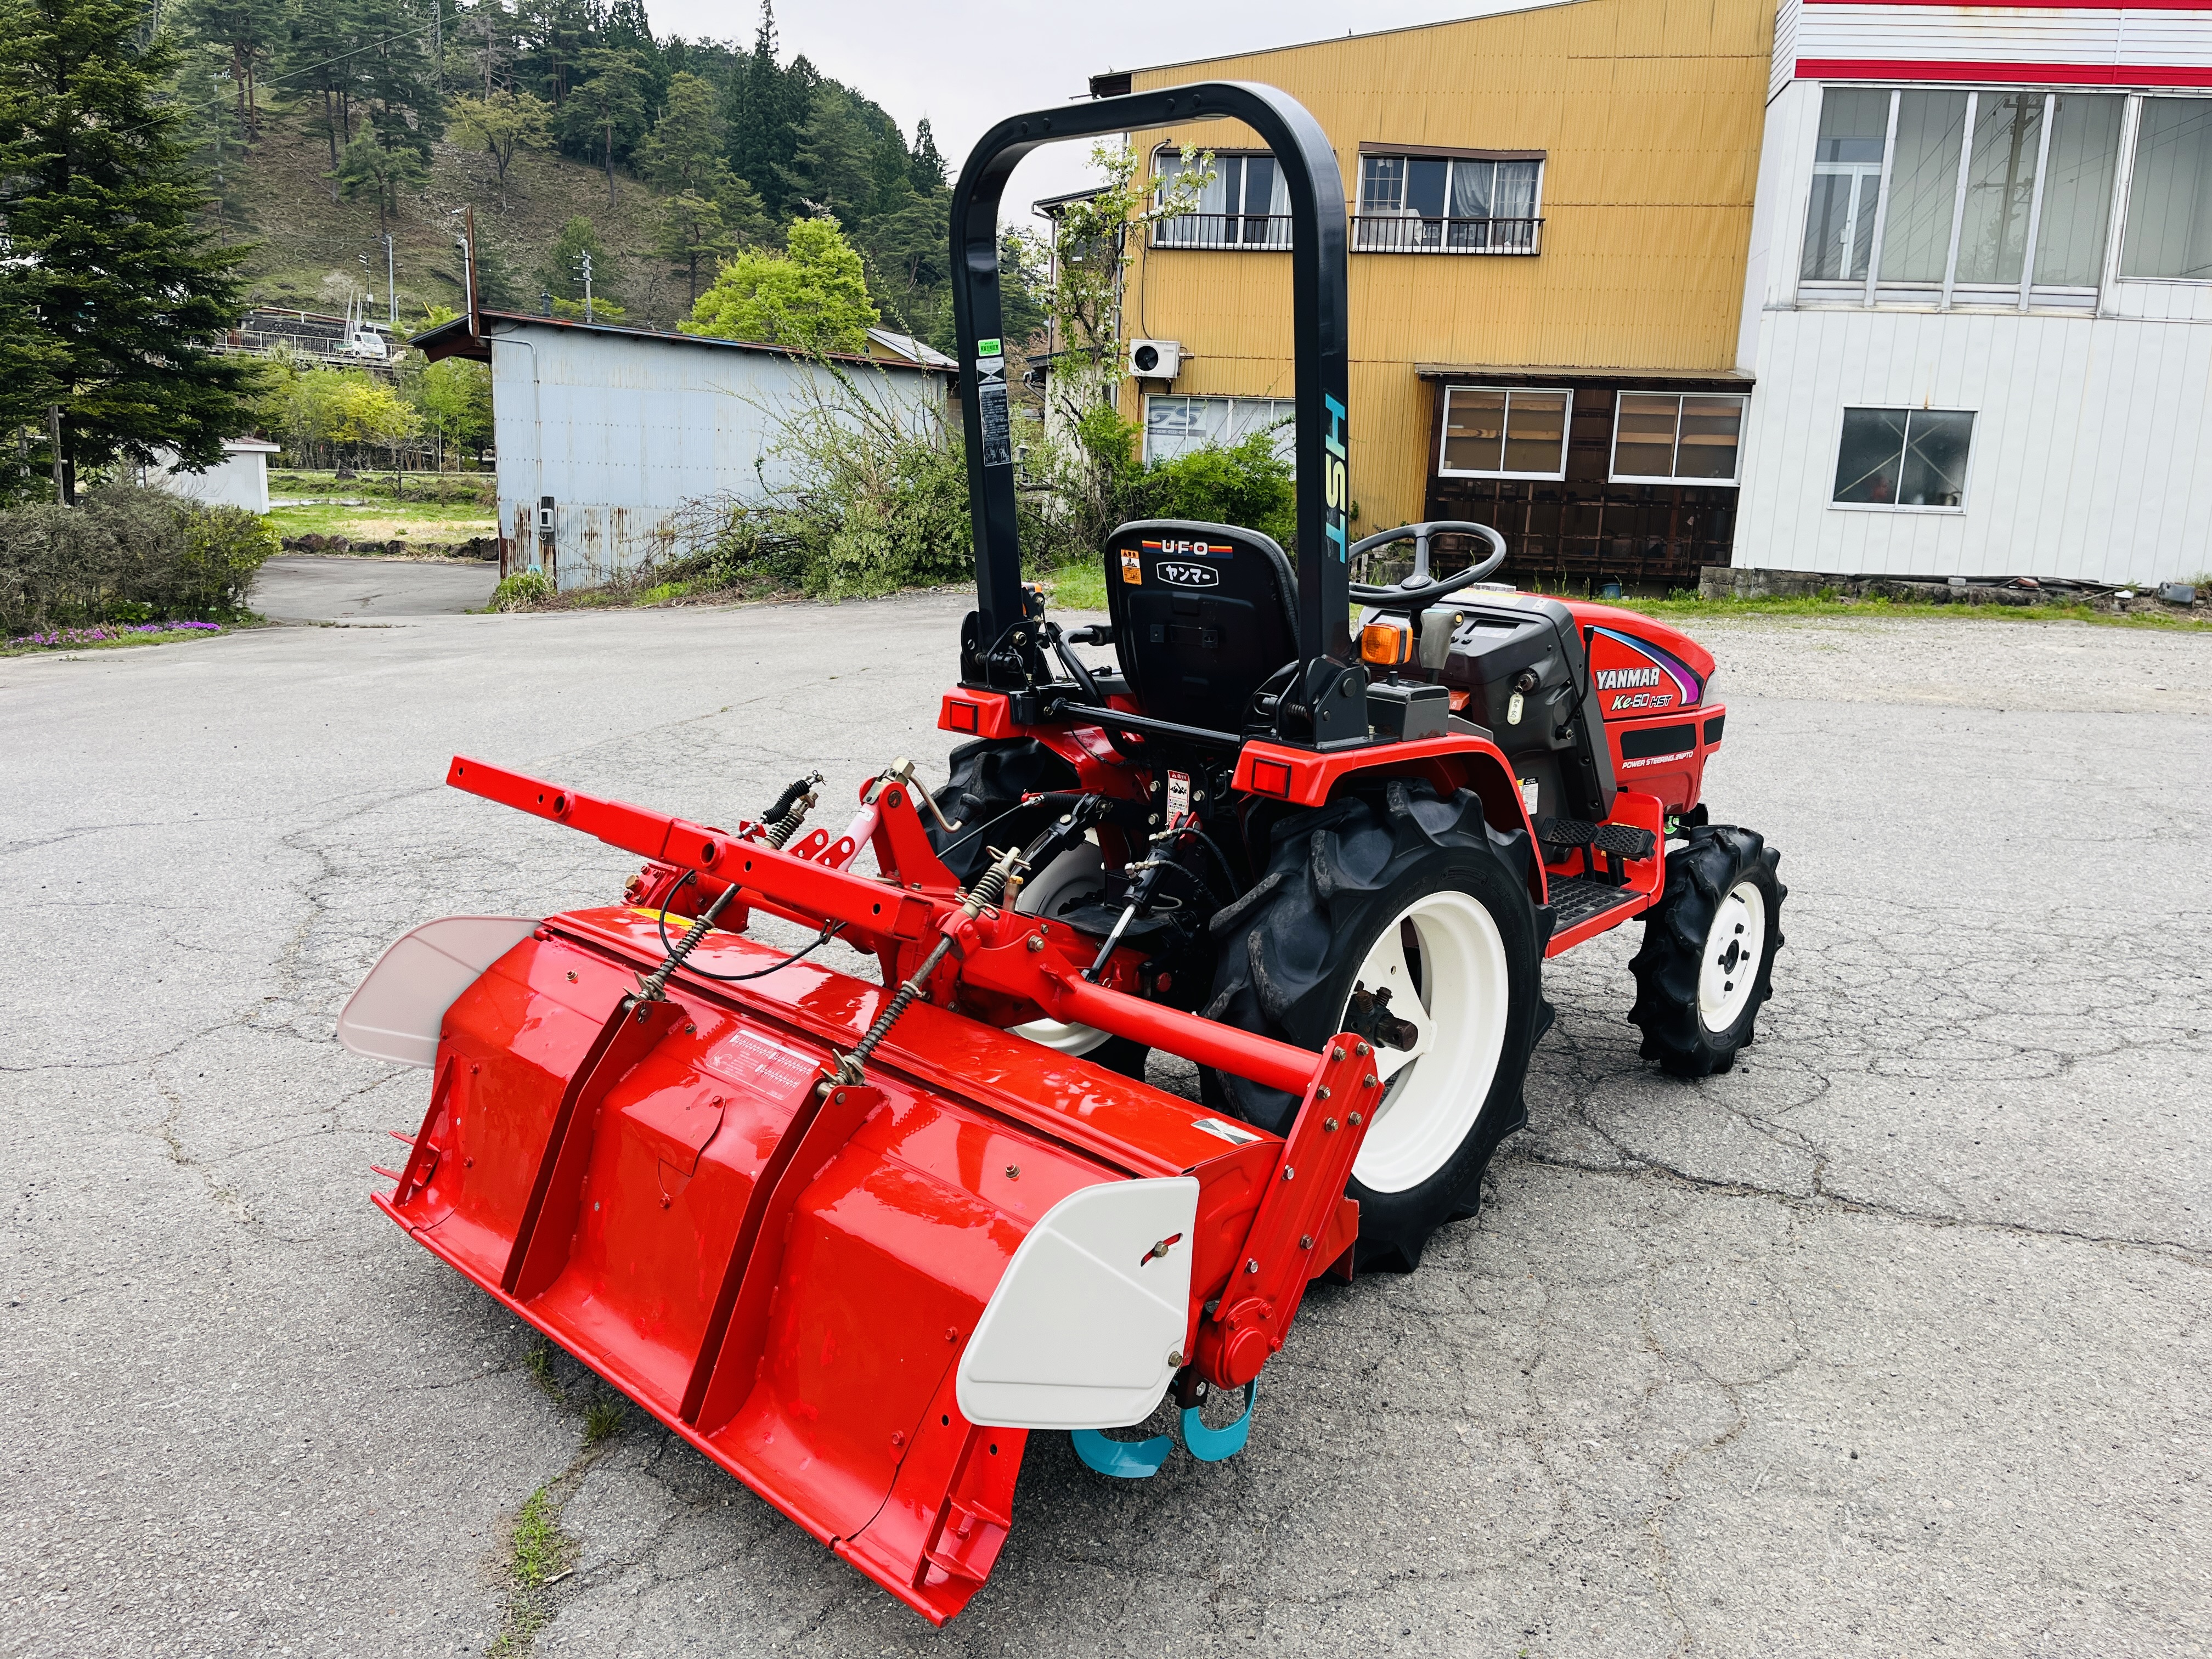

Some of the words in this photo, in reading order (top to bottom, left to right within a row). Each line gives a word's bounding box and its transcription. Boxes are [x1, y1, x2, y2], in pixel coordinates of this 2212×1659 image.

[1325, 393, 1345, 563] HST
[1161, 539, 1208, 556] UFO
[1165, 565, 1210, 583] ヤンマー
[1596, 667, 1660, 691] YANMAR
[1611, 693, 1650, 711] Ke-60
[1649, 694, 1673, 708] HST
[1622, 759, 1646, 769] POWER
